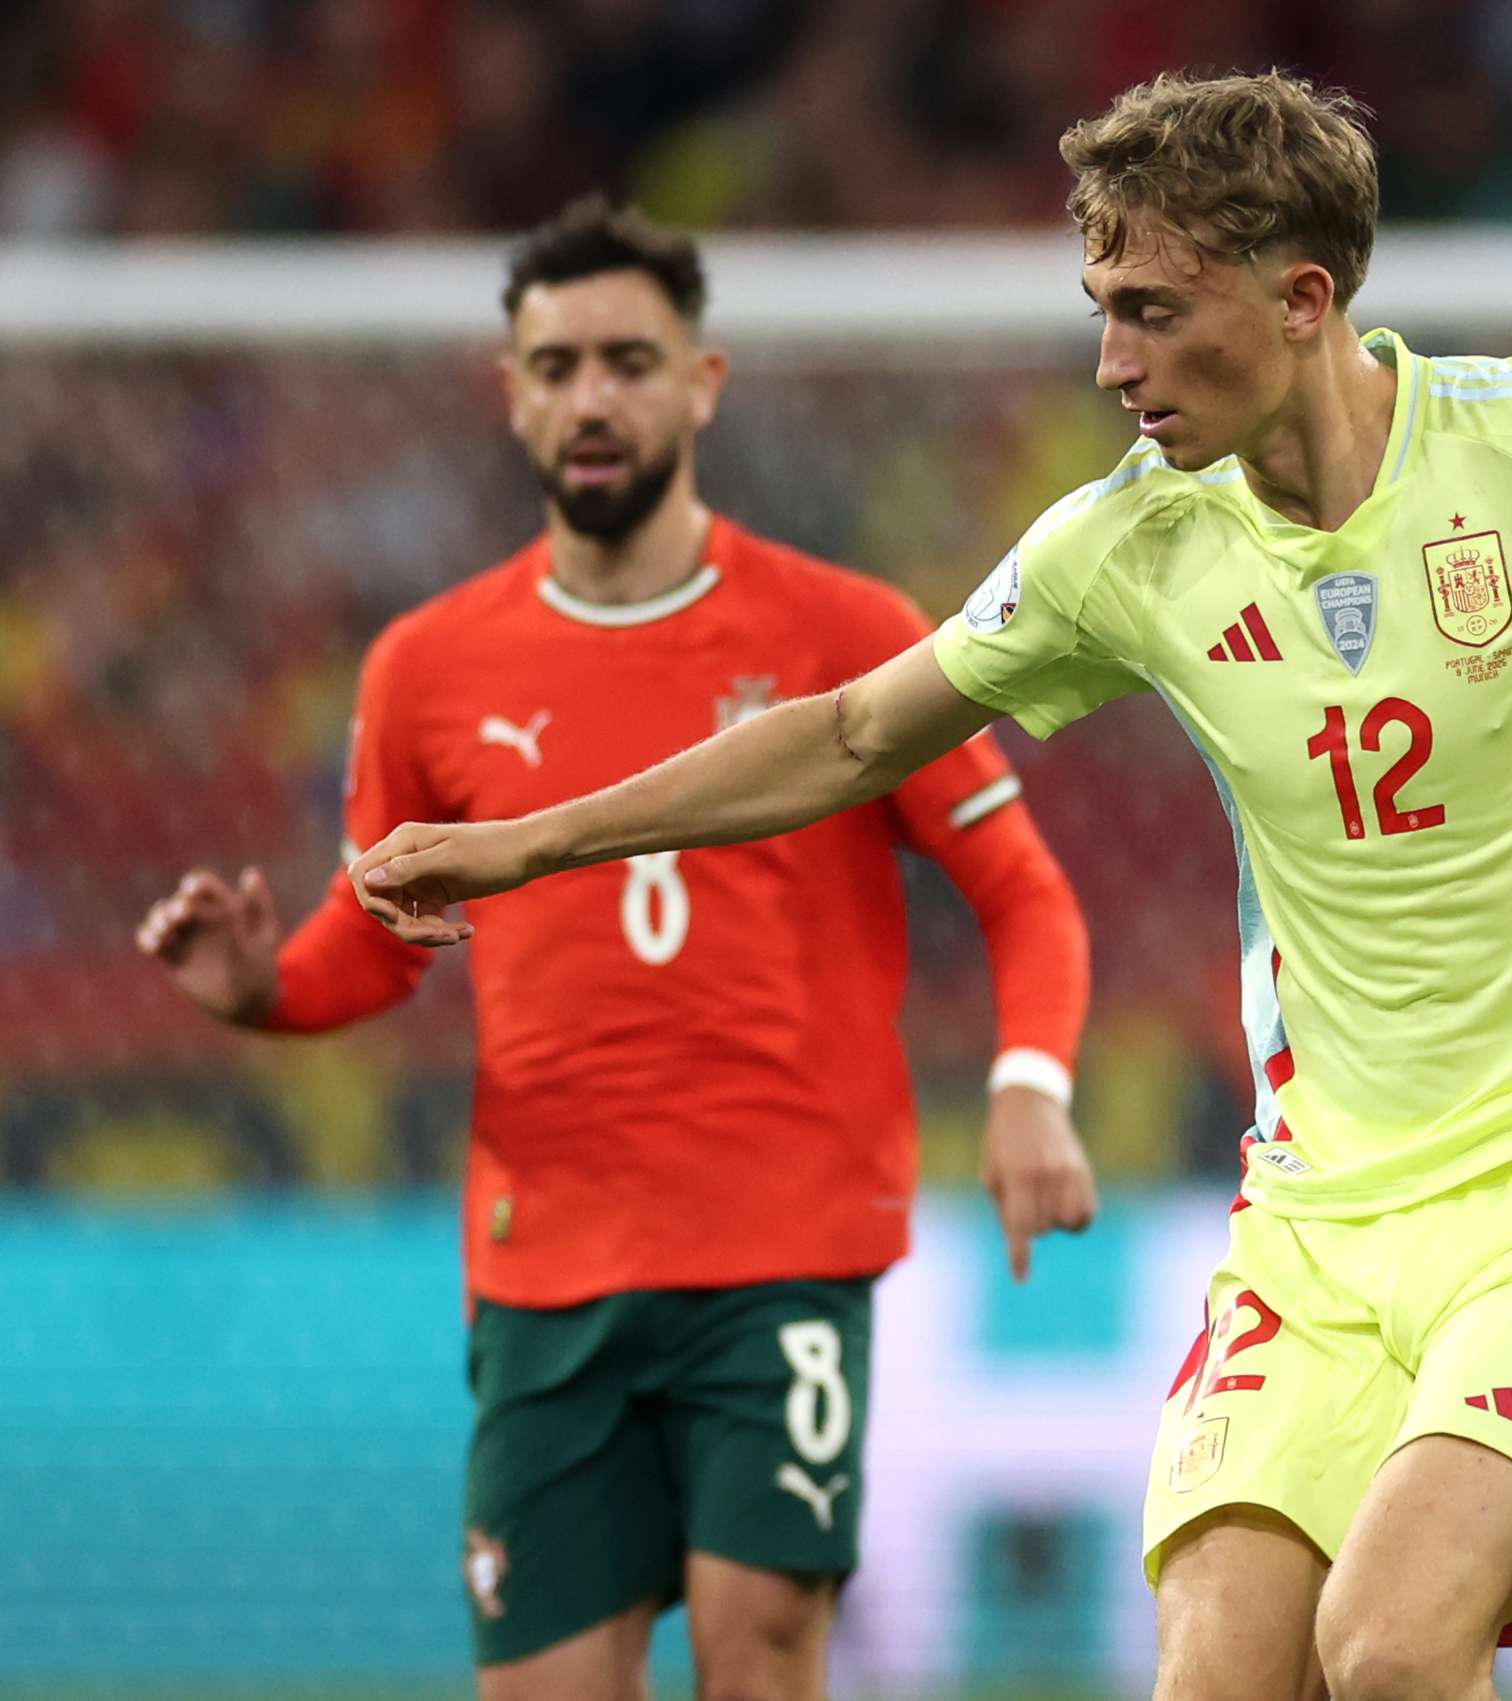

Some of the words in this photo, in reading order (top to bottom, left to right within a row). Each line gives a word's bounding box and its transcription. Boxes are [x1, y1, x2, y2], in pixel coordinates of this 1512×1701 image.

[1320, 583, 1371, 600] EUROPEAN
[1321, 594, 1372, 610] CHAMPIONS
[1338, 637, 1365, 652] 2024
[1445, 655, 1484, 669] PORTUGAL
[1467, 670, 1499, 684] MUNICH
[1307, 696, 1446, 841] 12
[777, 1317, 852, 1465] 8
